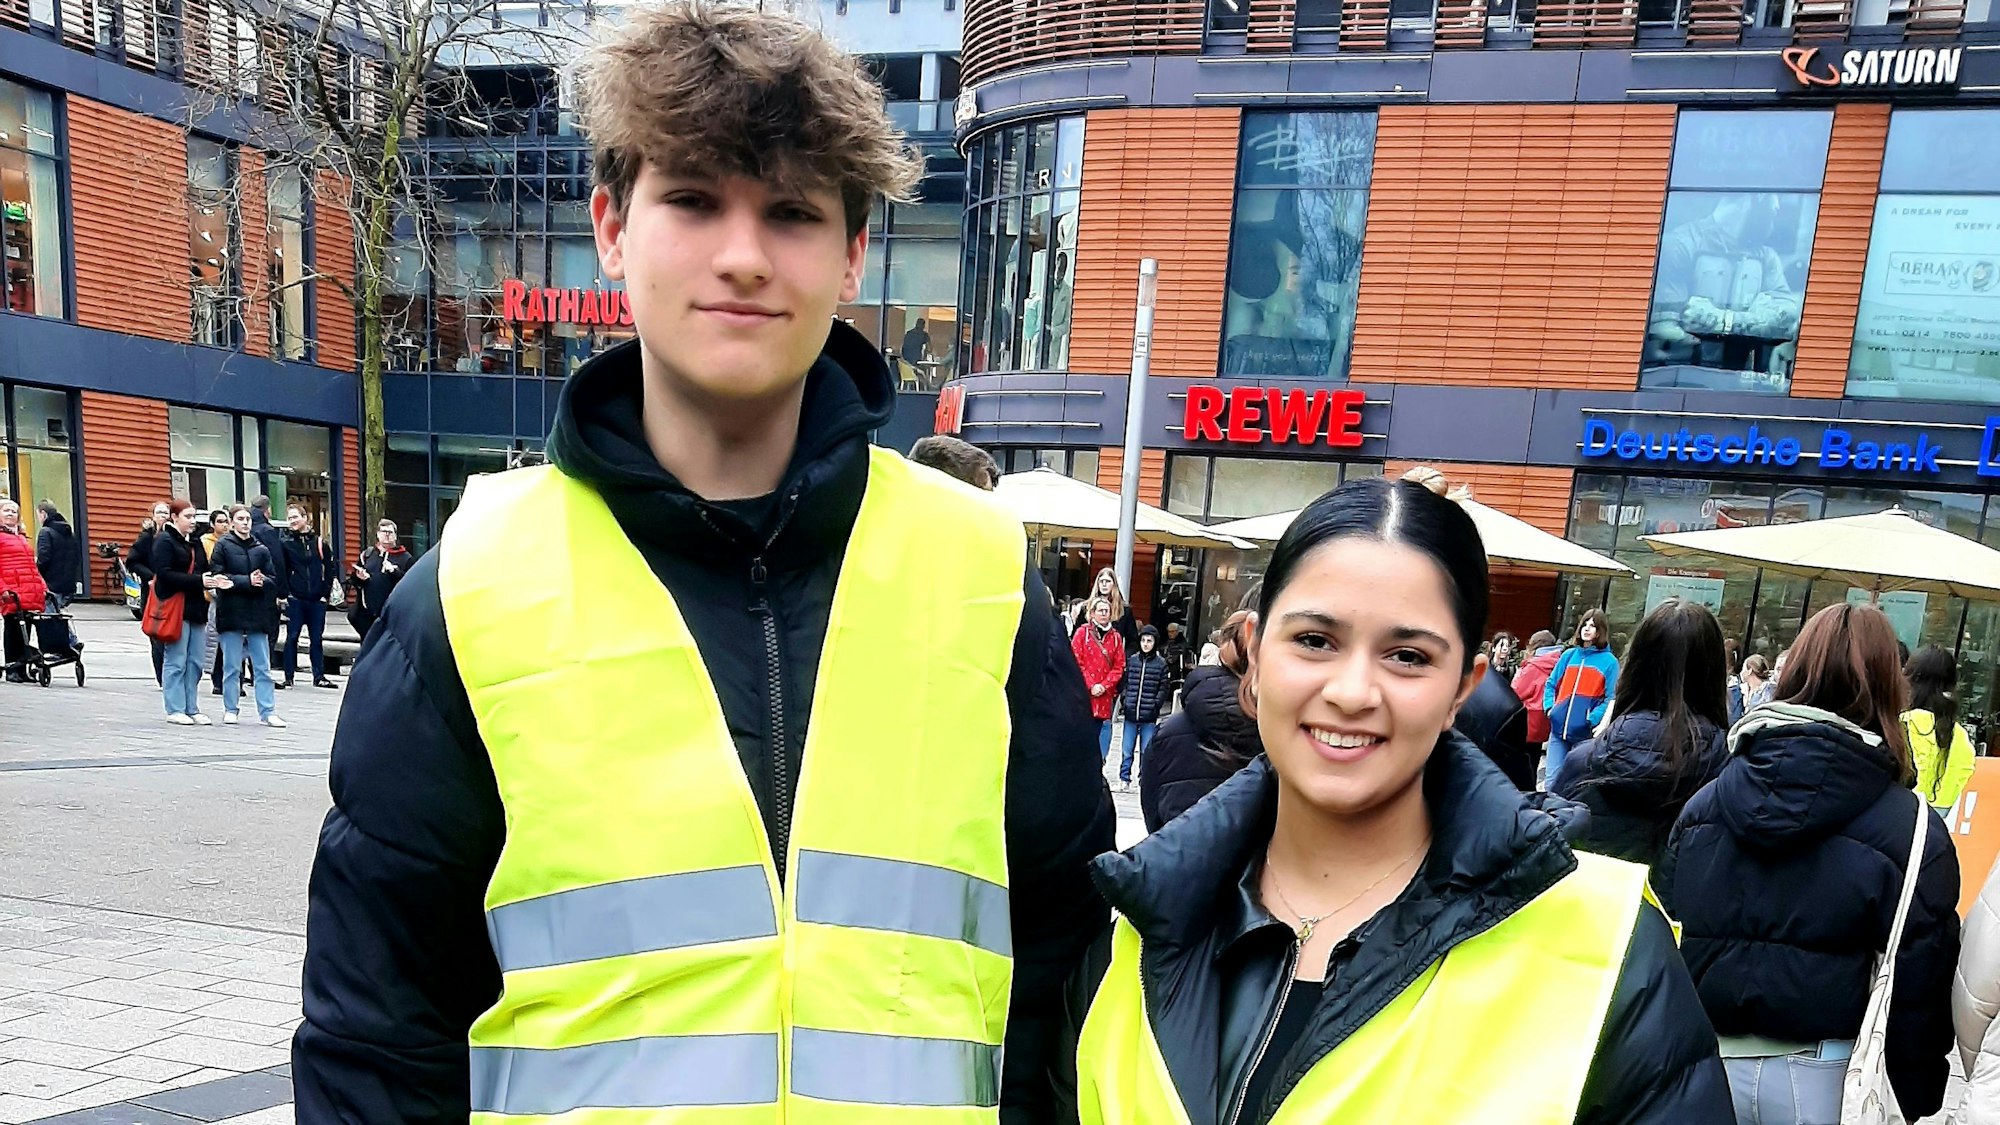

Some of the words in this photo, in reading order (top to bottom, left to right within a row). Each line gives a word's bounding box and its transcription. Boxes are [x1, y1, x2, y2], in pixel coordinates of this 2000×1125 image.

[1841, 48, 1962, 84] SATURN
[1184, 384, 1366, 447] REWE
[1582, 419, 1800, 467] Deutsche
[1819, 427, 1942, 473] Bank
